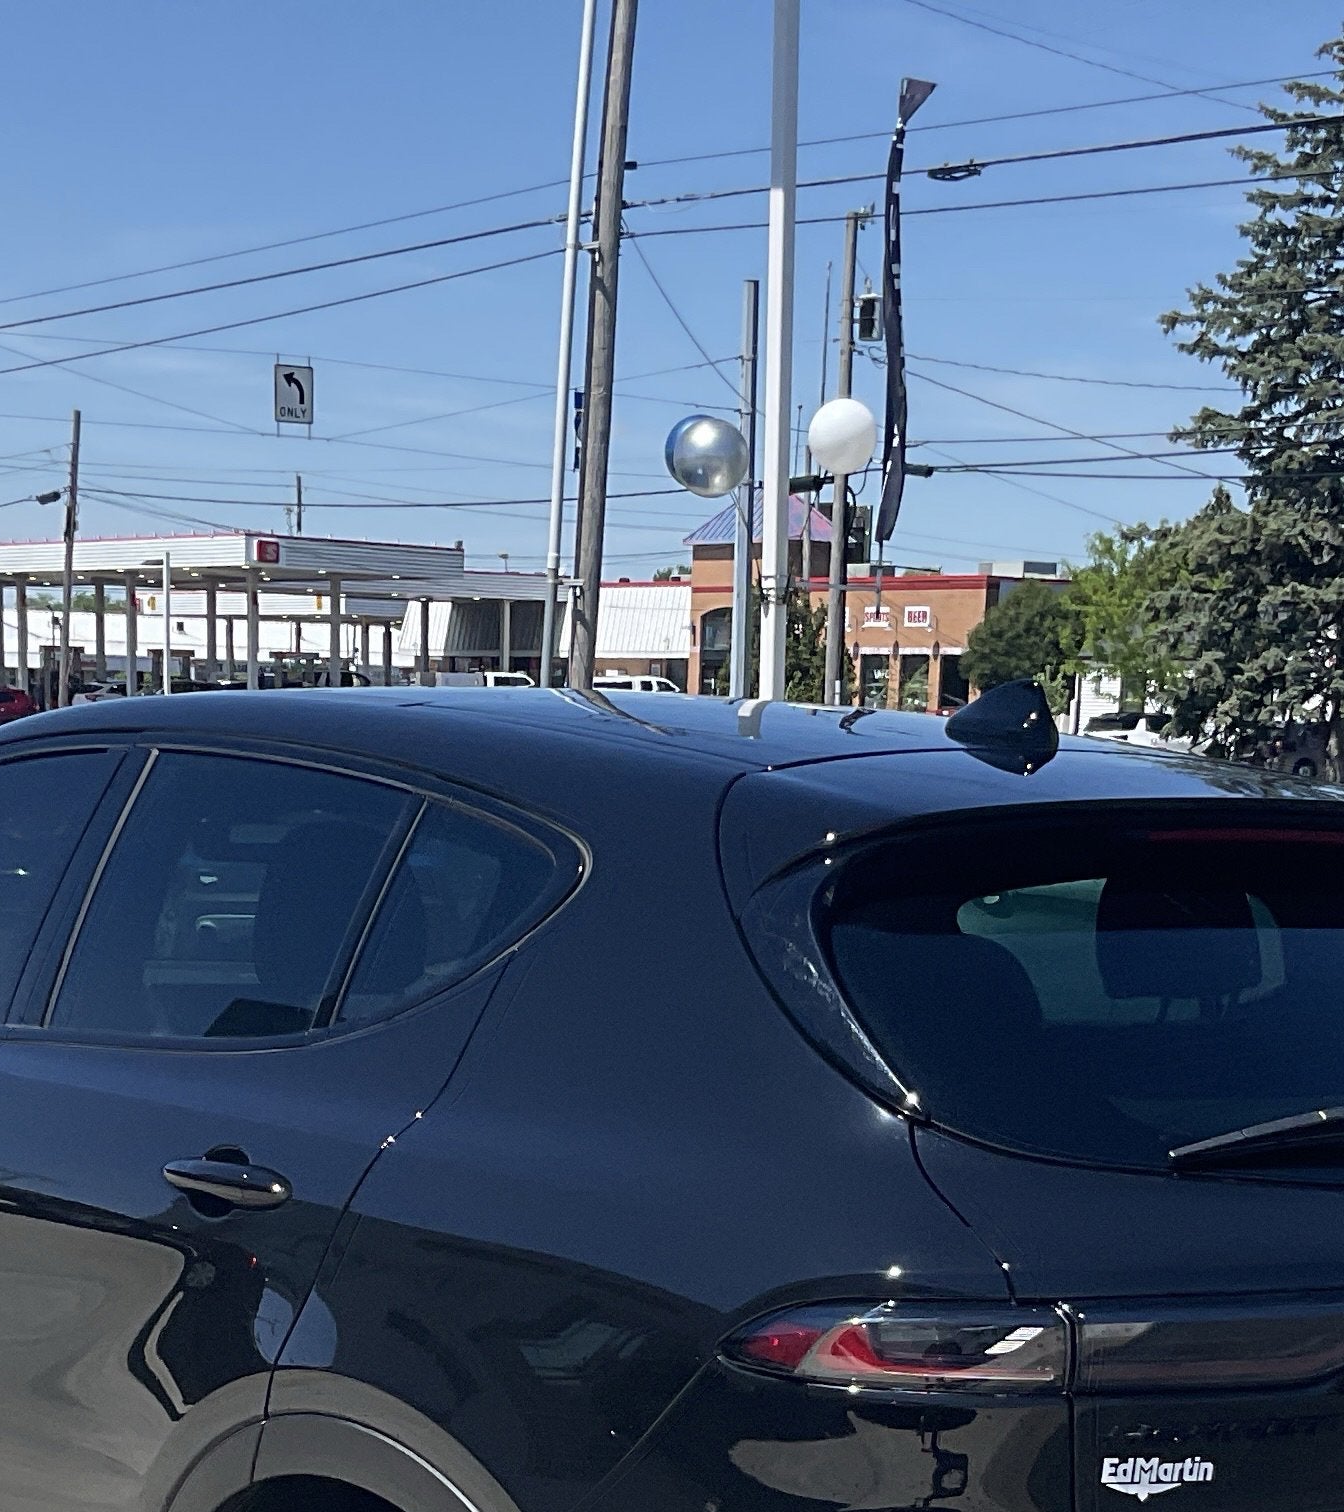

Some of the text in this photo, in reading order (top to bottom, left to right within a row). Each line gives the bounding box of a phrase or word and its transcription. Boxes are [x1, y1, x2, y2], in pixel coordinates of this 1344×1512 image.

[279, 406, 307, 418] ONLY
[907, 610, 928, 623] BEER
[1101, 1456, 1214, 1484] EdMartin
